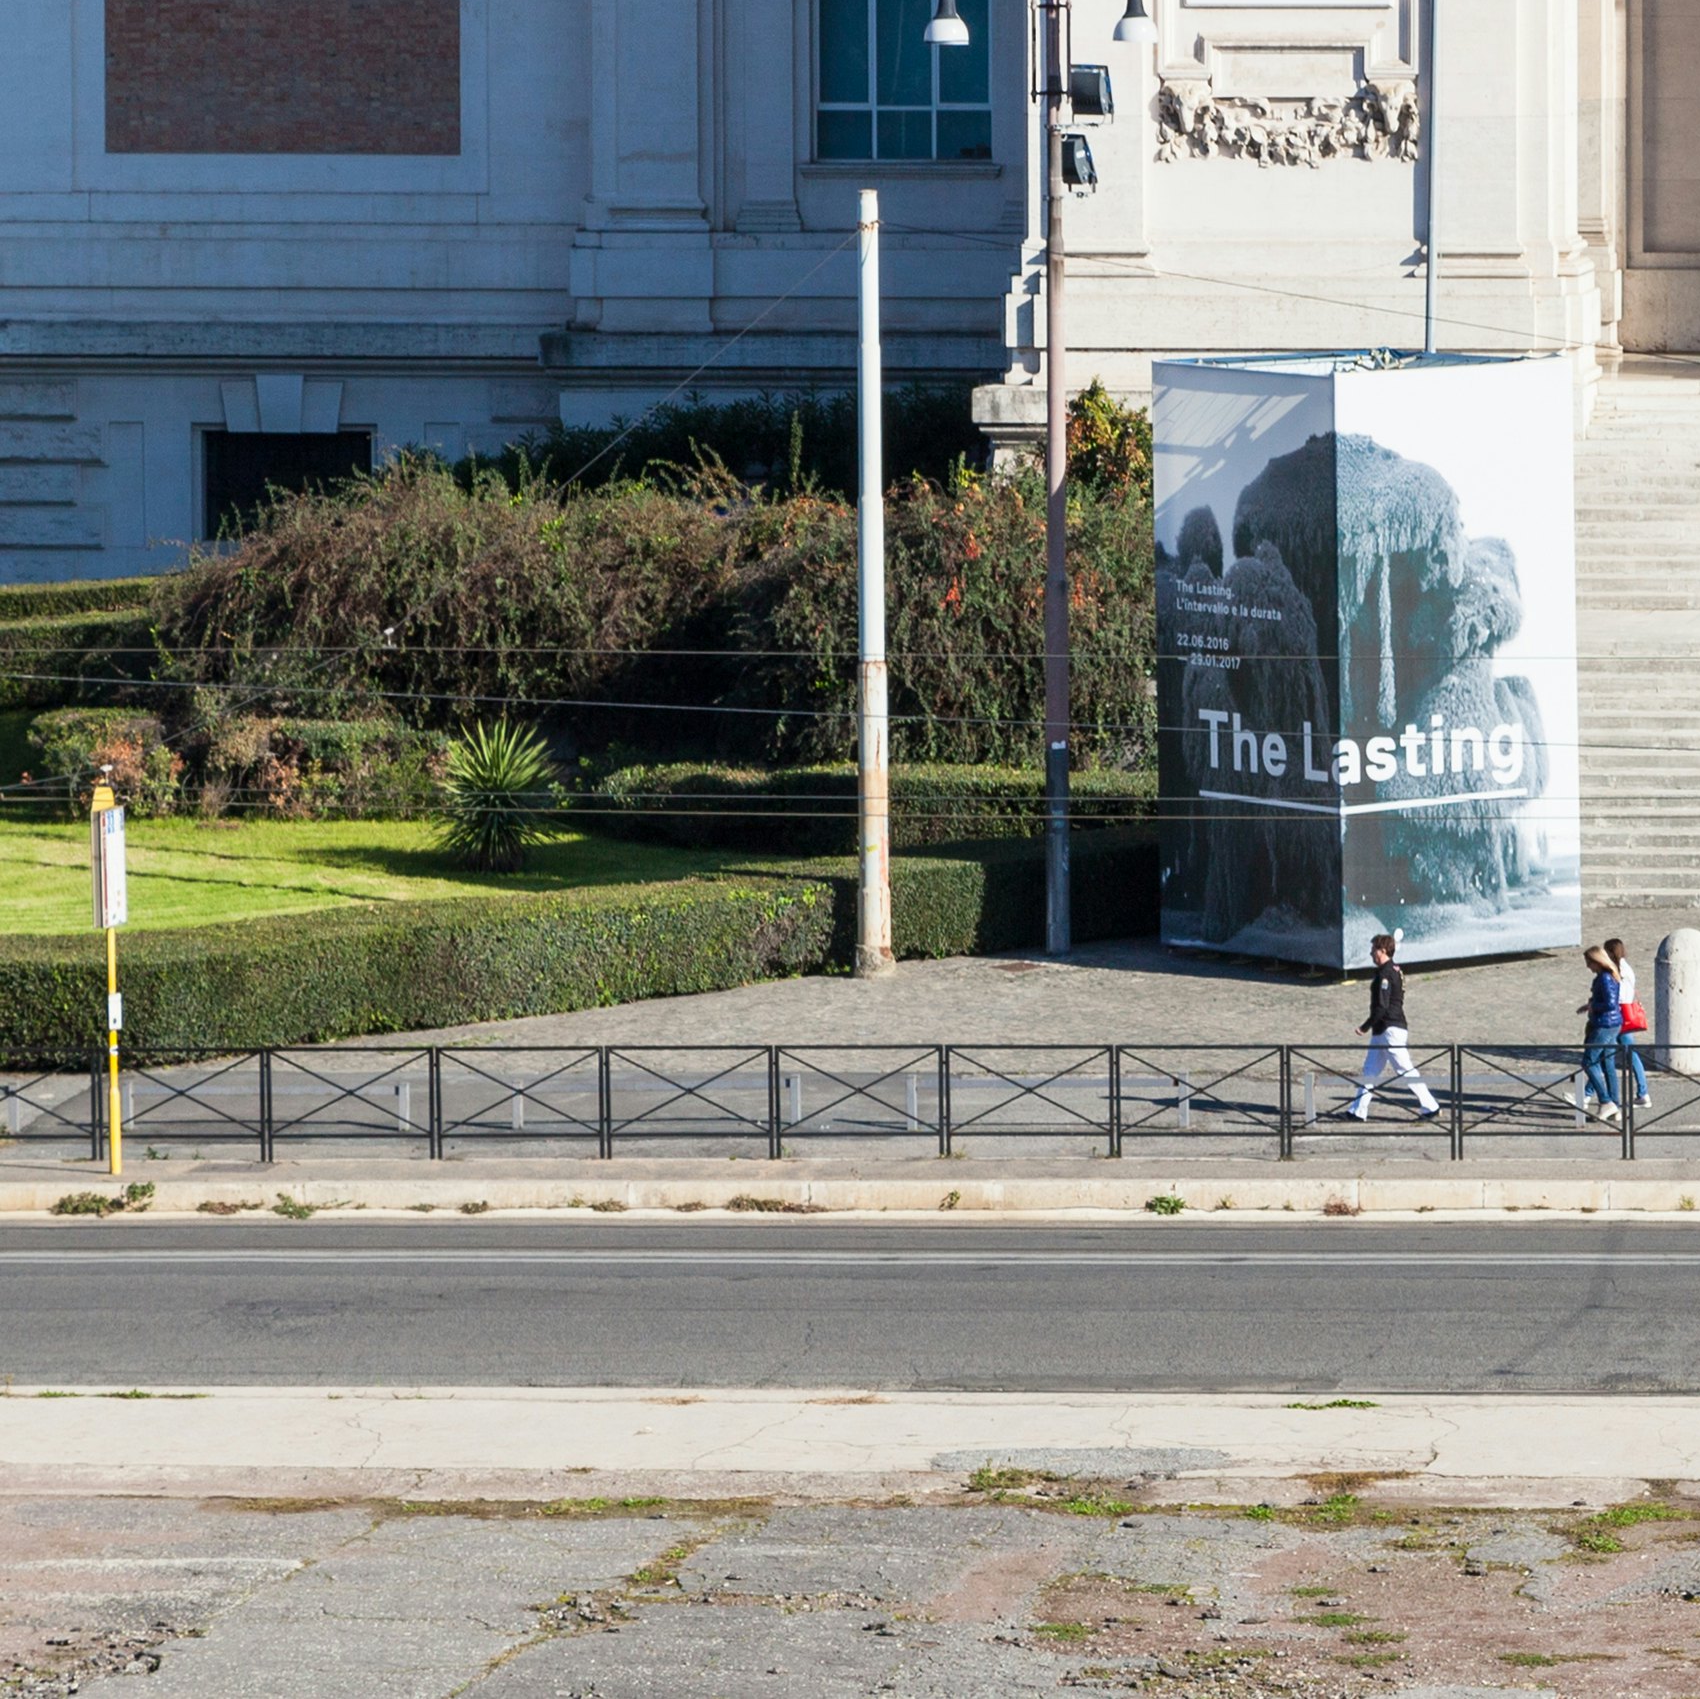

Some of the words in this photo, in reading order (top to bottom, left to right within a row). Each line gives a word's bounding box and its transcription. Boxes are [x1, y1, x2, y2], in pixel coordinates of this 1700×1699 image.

[1176, 580, 1193, 593] The
[1196, 582, 1235, 600] Lasting.
[1176, 598, 1230, 615] L'intervallo
[1231, 608, 1238, 616] e
[1240, 604, 1248, 617] la
[1250, 606, 1282, 620] durata
[1177, 634, 1229, 651] 22.06.2016
[1199, 709, 1288, 777] The
[1303, 714, 1524, 786] Lasting
